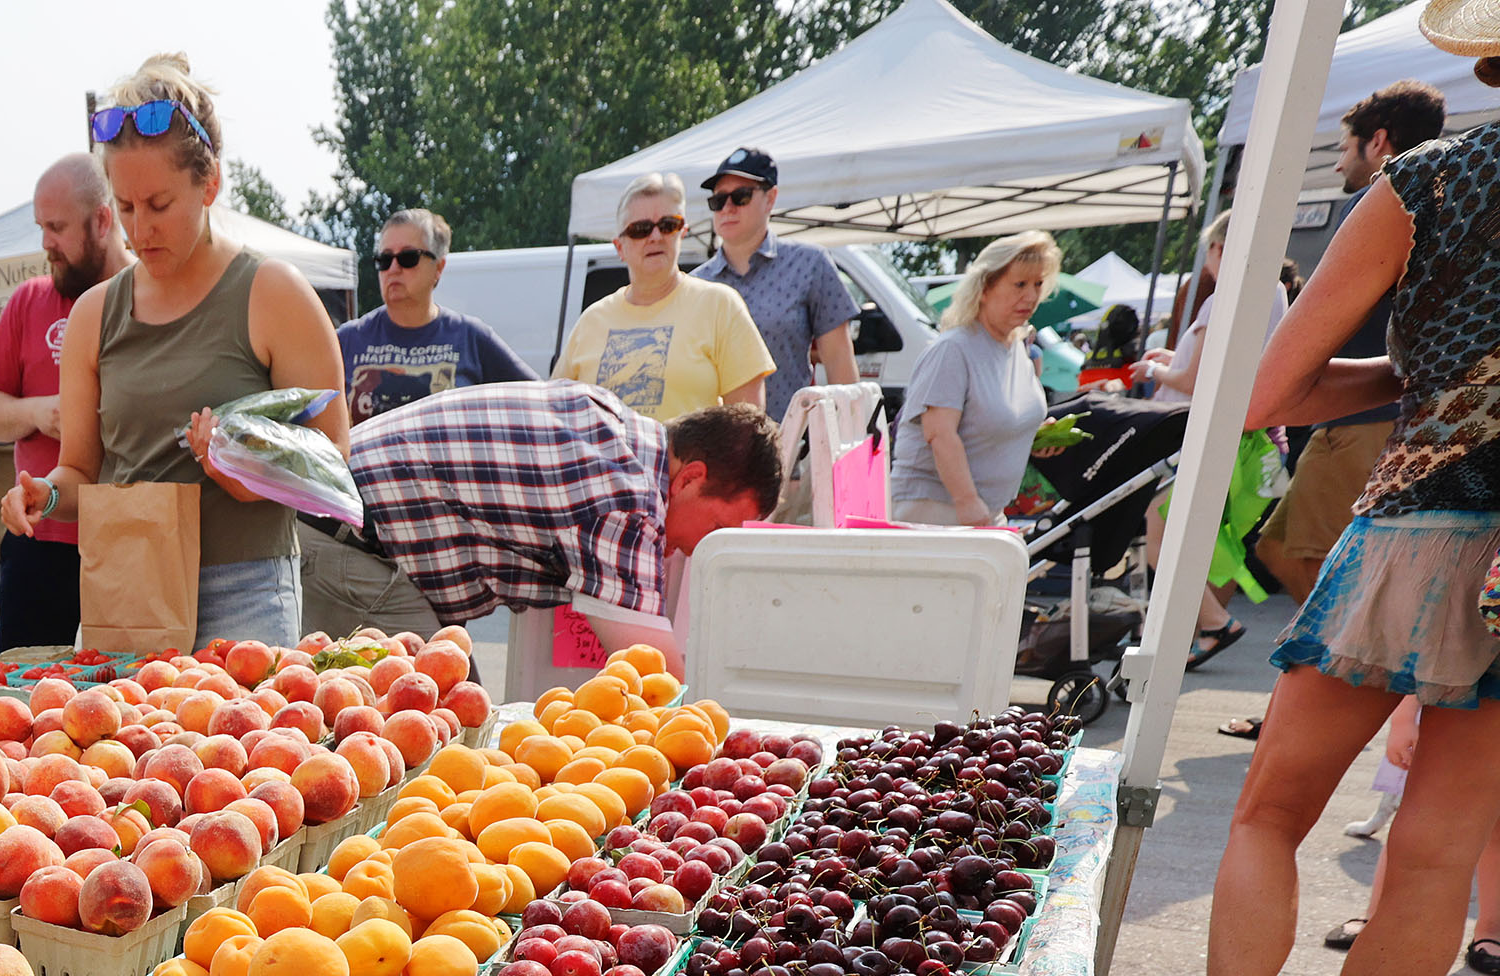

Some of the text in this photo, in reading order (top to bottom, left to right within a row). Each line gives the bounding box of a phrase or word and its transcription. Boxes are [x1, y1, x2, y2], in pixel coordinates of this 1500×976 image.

[367, 344, 408, 355] BEFORE
[353, 351, 460, 365] I HATE EVERYONE
